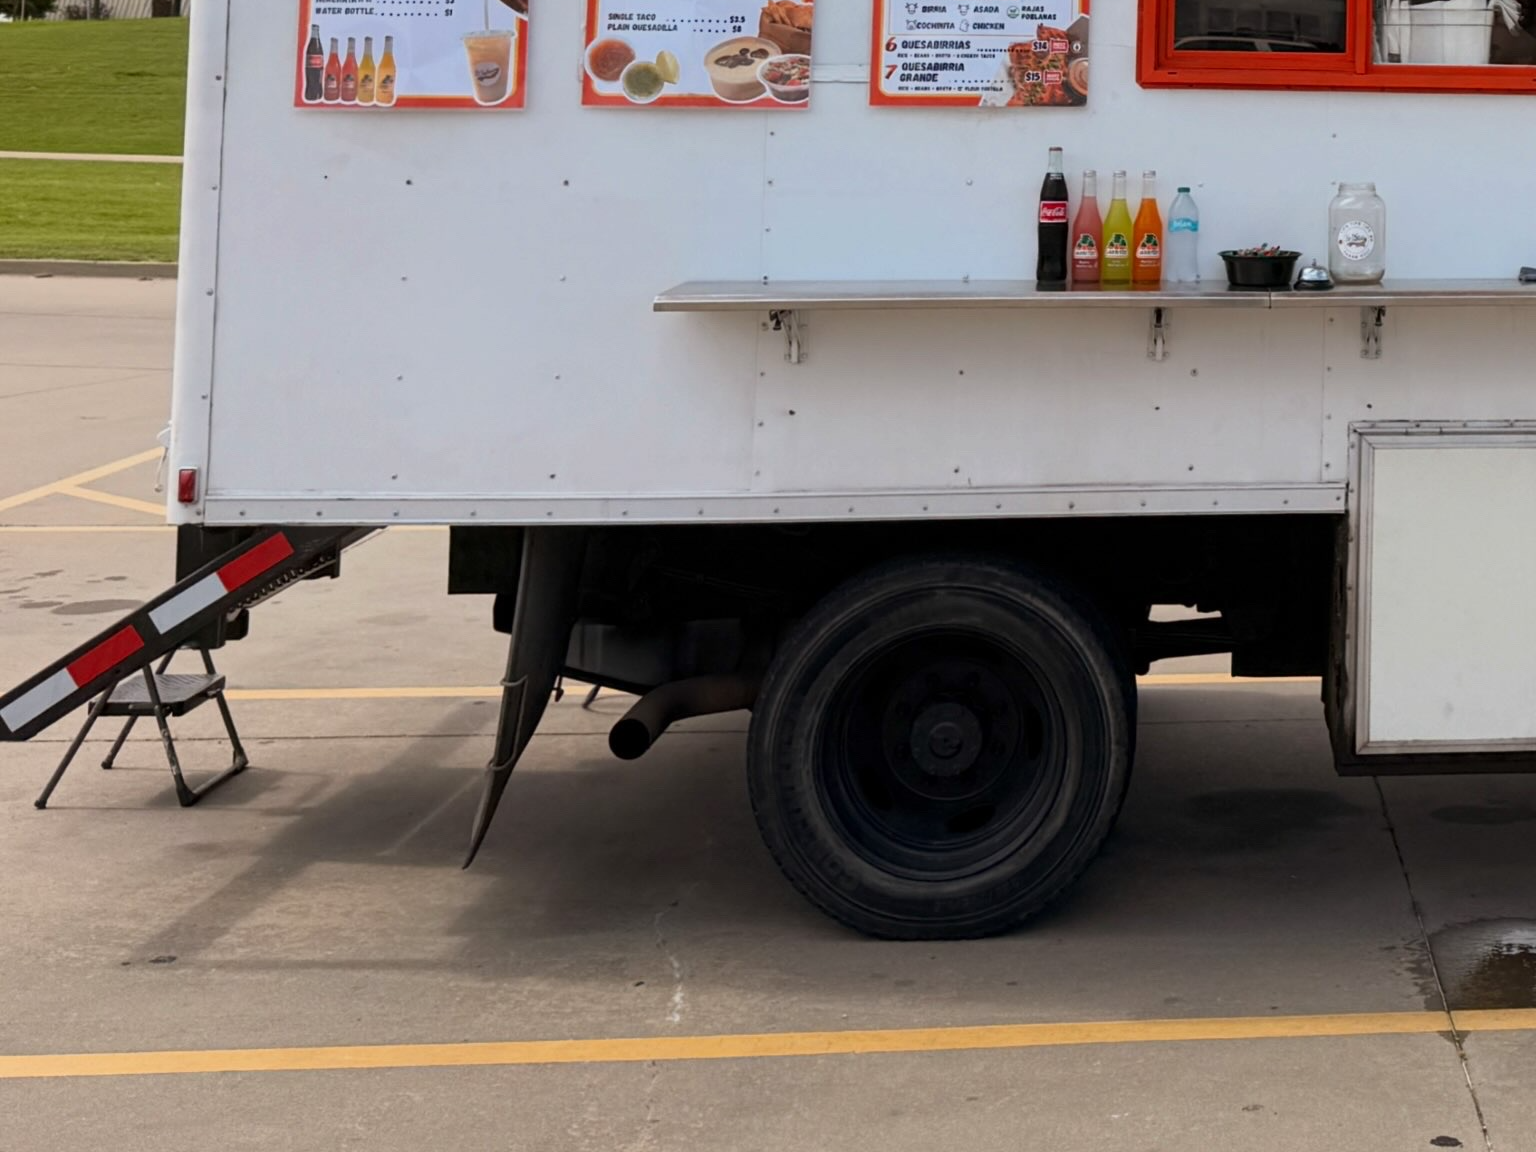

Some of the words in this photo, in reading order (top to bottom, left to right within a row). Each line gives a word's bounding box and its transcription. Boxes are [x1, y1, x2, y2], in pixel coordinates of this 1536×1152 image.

[885, 36, 898, 52] 6
[901, 40, 971, 50] QUESABIRRIAS
[885, 64, 898, 80] 7
[902, 63, 965, 71] QUESABIRRIA
[899, 73, 939, 82] GRANDE
